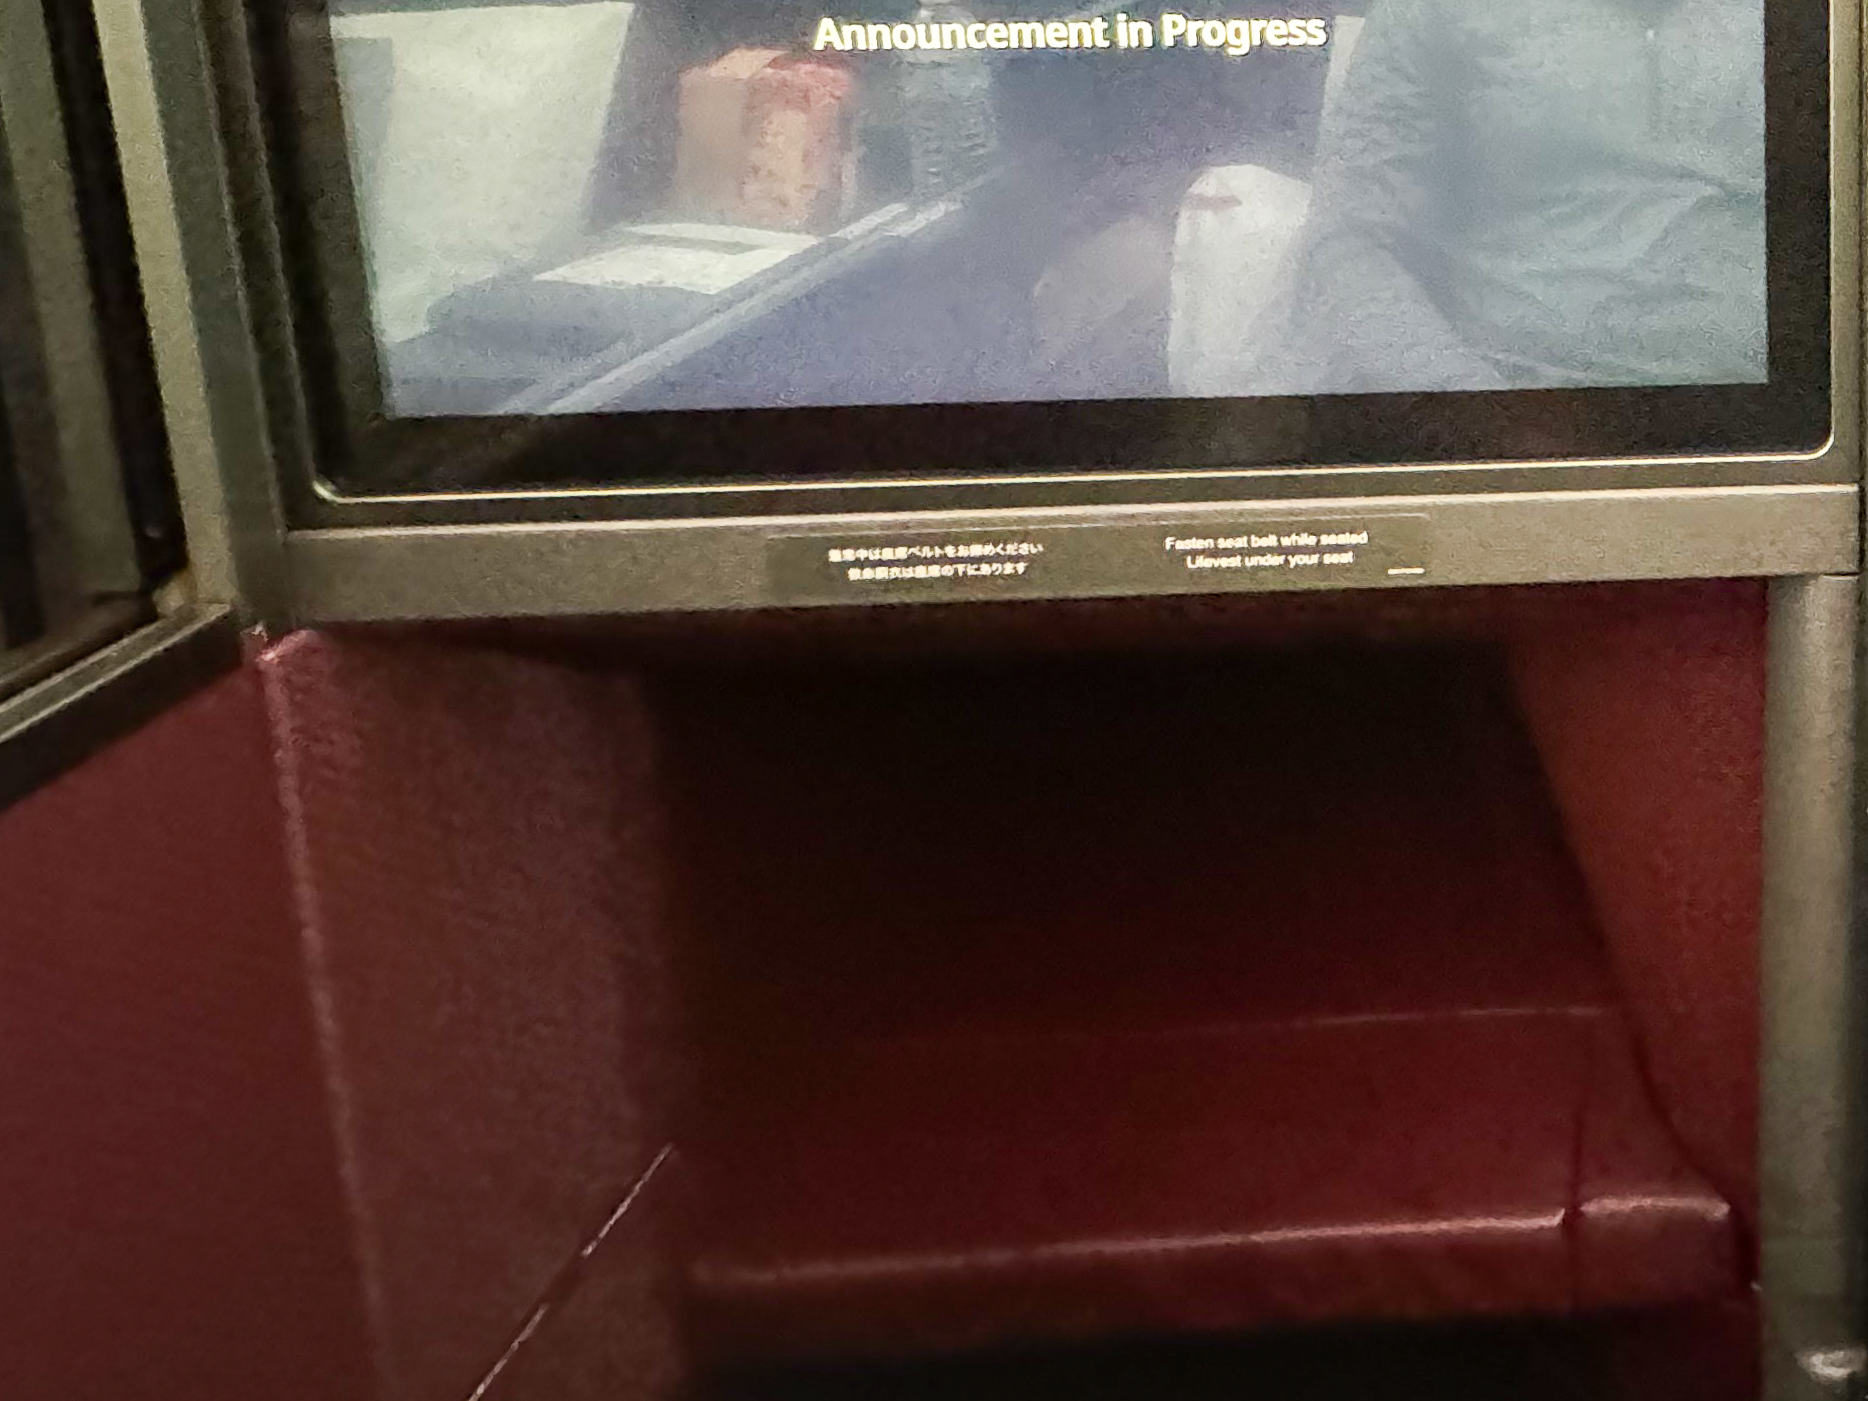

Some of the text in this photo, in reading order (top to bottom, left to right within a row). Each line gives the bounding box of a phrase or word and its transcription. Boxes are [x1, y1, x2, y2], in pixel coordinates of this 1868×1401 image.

[814, 13, 1328, 56] Announcement in Progress
[1165, 531, 1369, 550] Fasten seat belt while seated
[1244, 553, 1285, 566] under
[1288, 553, 1320, 569] your
[1322, 551, 1354, 565] seat
